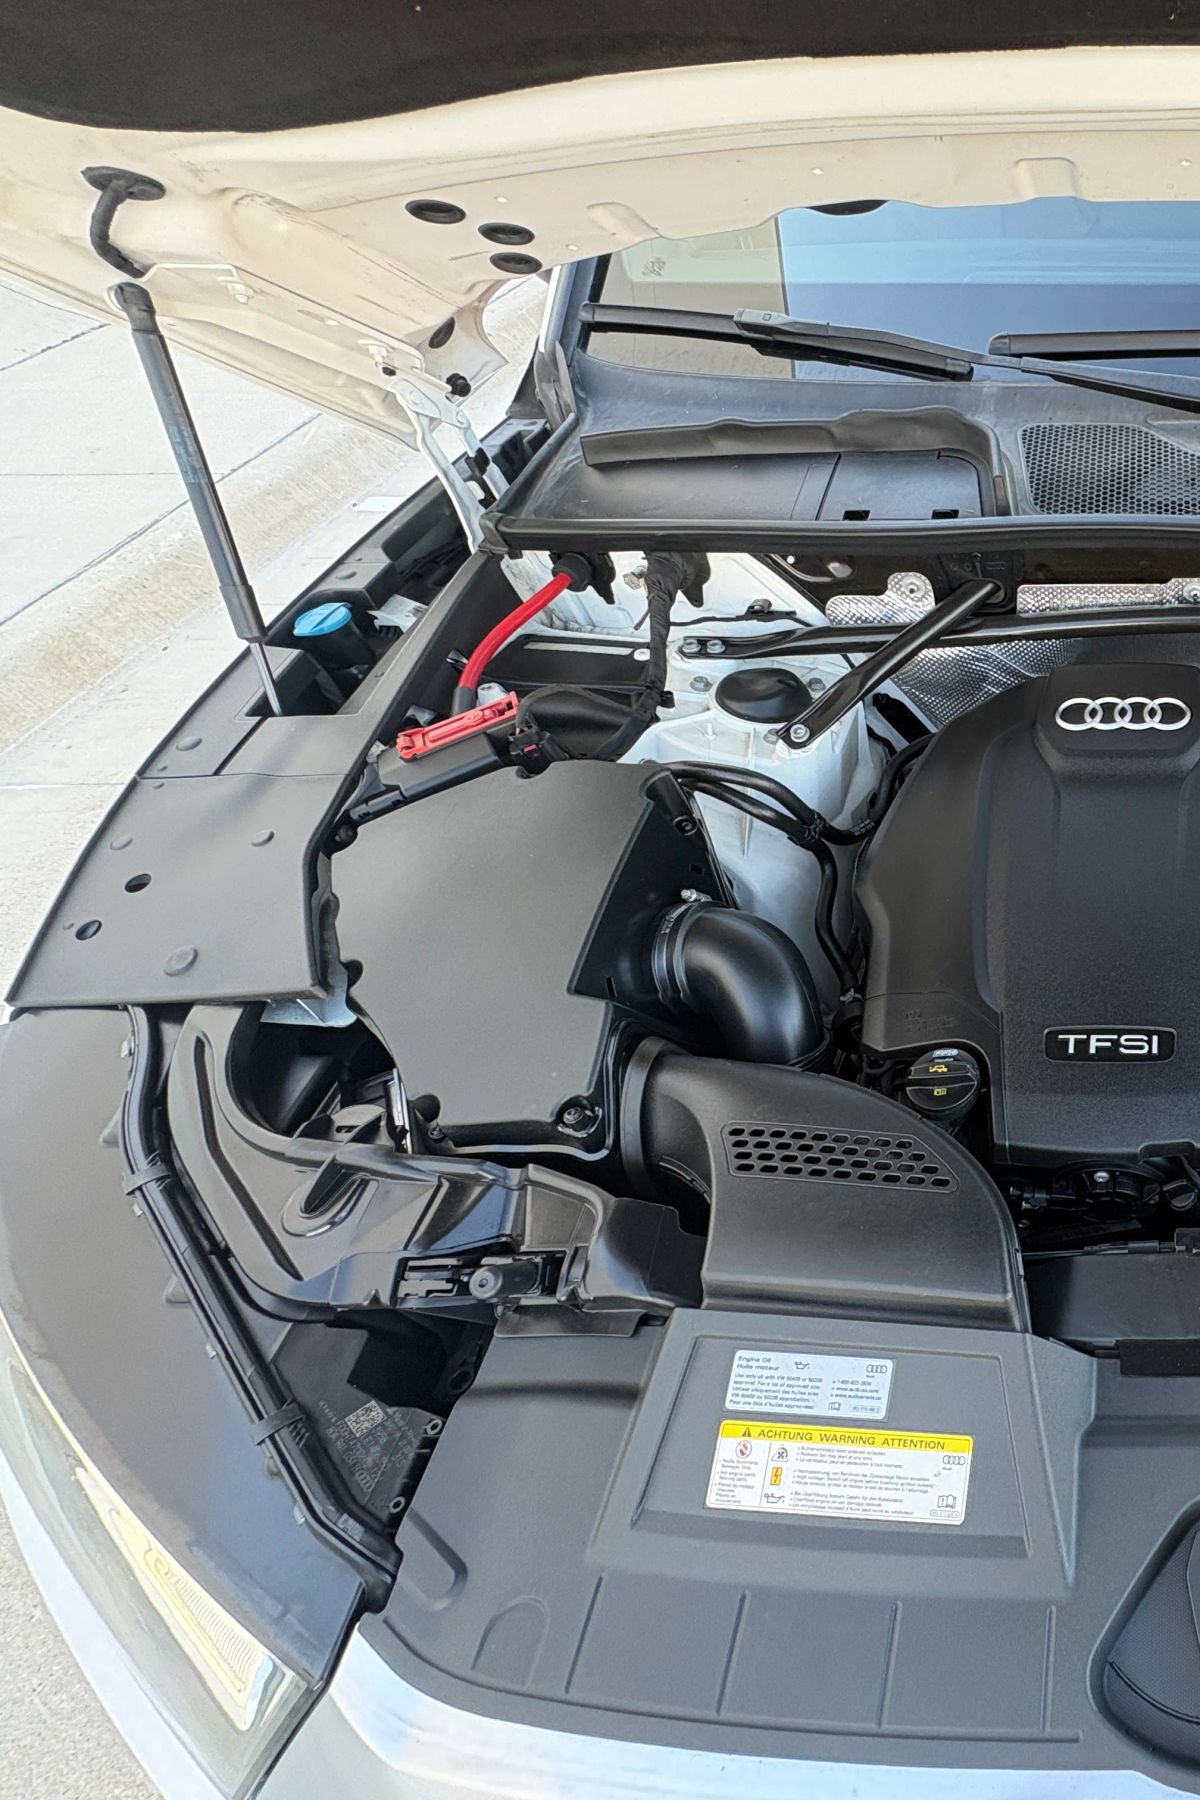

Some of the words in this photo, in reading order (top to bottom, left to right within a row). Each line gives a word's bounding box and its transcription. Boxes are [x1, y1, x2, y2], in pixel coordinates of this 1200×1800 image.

[1057, 1034, 1159, 1054] TFSI
[757, 1428, 813, 1442] ACHTUNG
[819, 1432, 876, 1446] WARNING
[881, 1437, 946, 1450] ATTENTION
